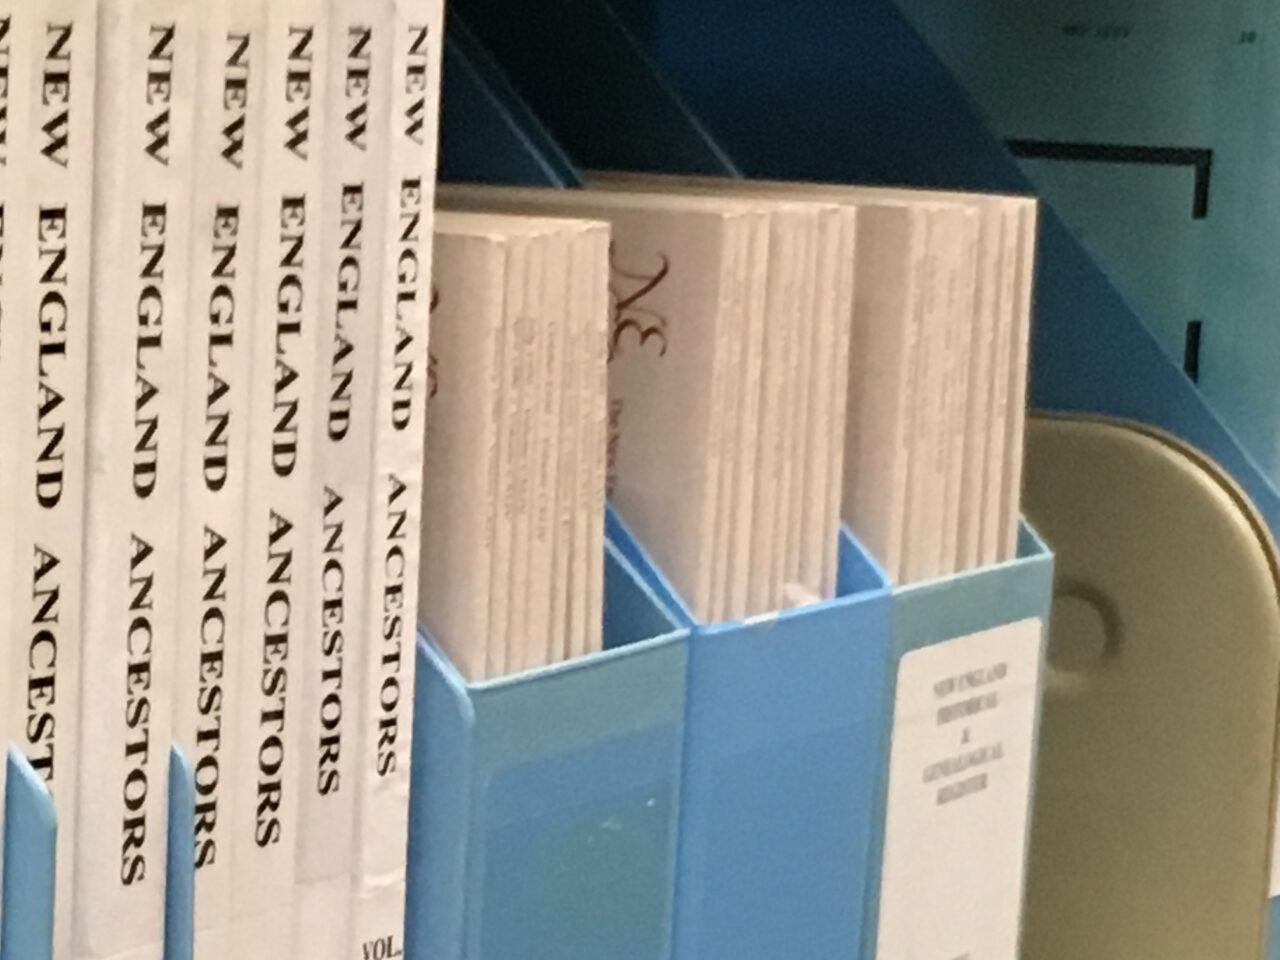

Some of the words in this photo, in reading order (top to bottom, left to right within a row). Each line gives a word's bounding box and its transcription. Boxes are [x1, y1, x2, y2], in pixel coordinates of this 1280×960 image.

[40, 20, 73, 170] NEW
[144, 23, 175, 166] NEW
[221, 32, 251, 170] NEW
[283, 24, 314, 161] NEW
[345, 25, 372, 152] NEW
[404, 24, 429, 146] NEW
[35, 203, 67, 510] ENGLAND
[132, 200, 167, 499] ENGLAND
[202, 204, 239, 492] ENGLAND
[271, 193, 306, 478] ENGLAND
[328, 182, 364, 443] ENGLAND
[392, 176, 422, 432] ENGLAND
[25, 543, 62, 790] ANCEST
[120, 532, 154, 887] ANCESTORS
[194, 524, 228, 870] ANCESTORS
[255, 507, 294, 848] ANCESTORS
[317, 483, 345, 797] ANCESTORS
[376, 472, 408, 778] ANCESTORS
